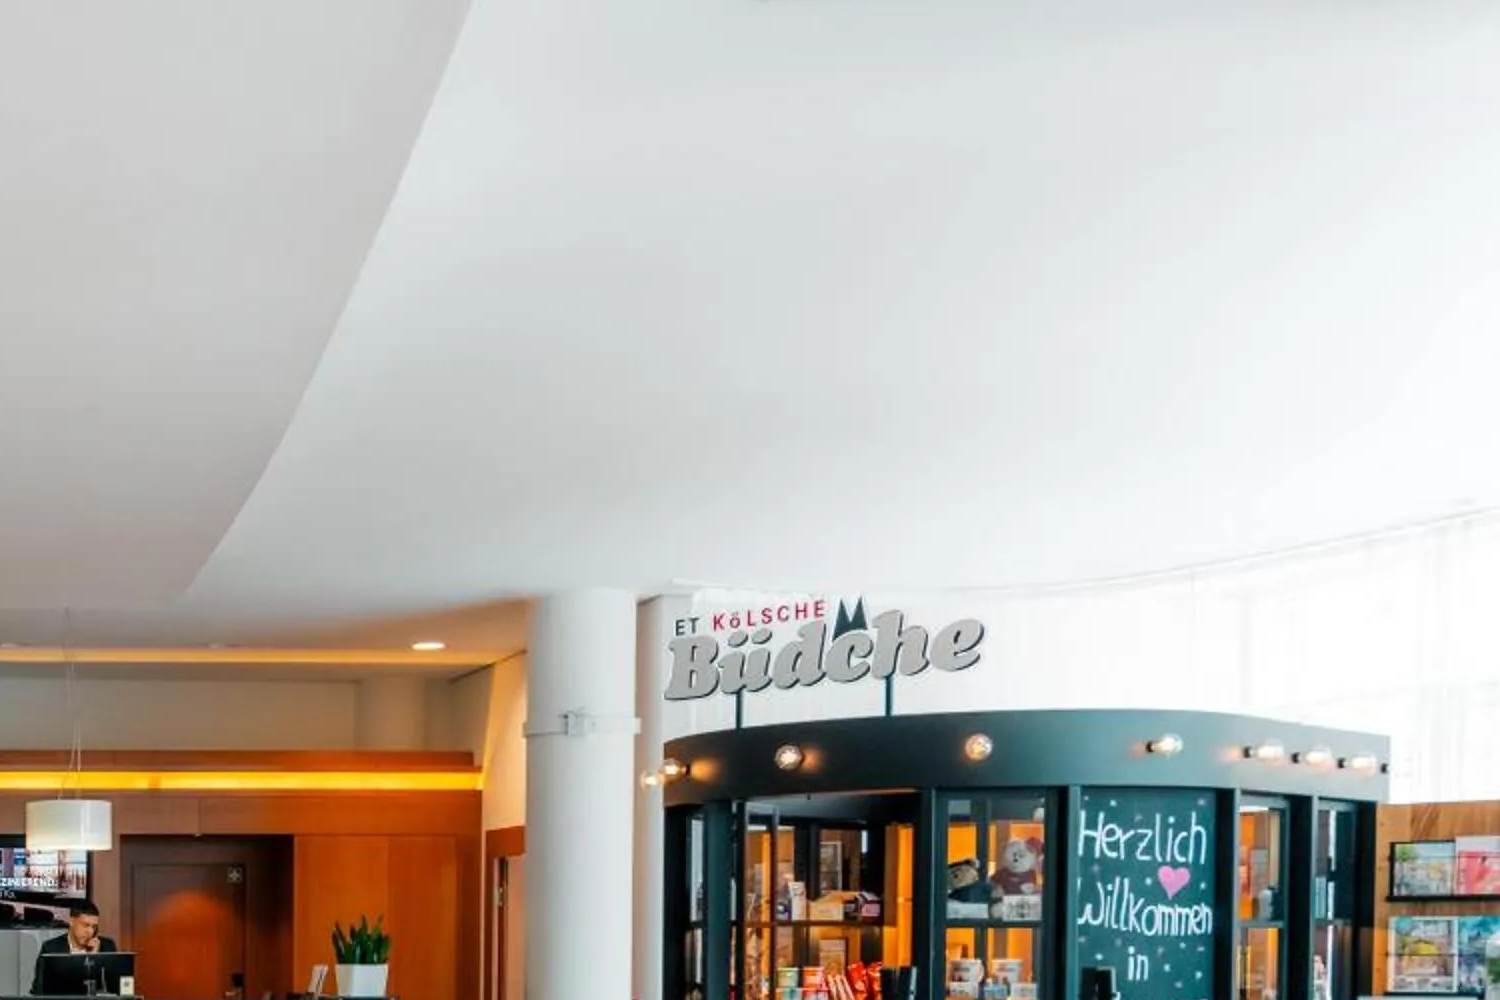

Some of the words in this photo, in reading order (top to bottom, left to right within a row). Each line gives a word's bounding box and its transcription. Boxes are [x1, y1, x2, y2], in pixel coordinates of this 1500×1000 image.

[675, 617, 700, 637] ET
[663, 608, 986, 701] Büdche
[1077, 809, 1208, 865] Herzlich
[1126, 945, 1149, 982] in
